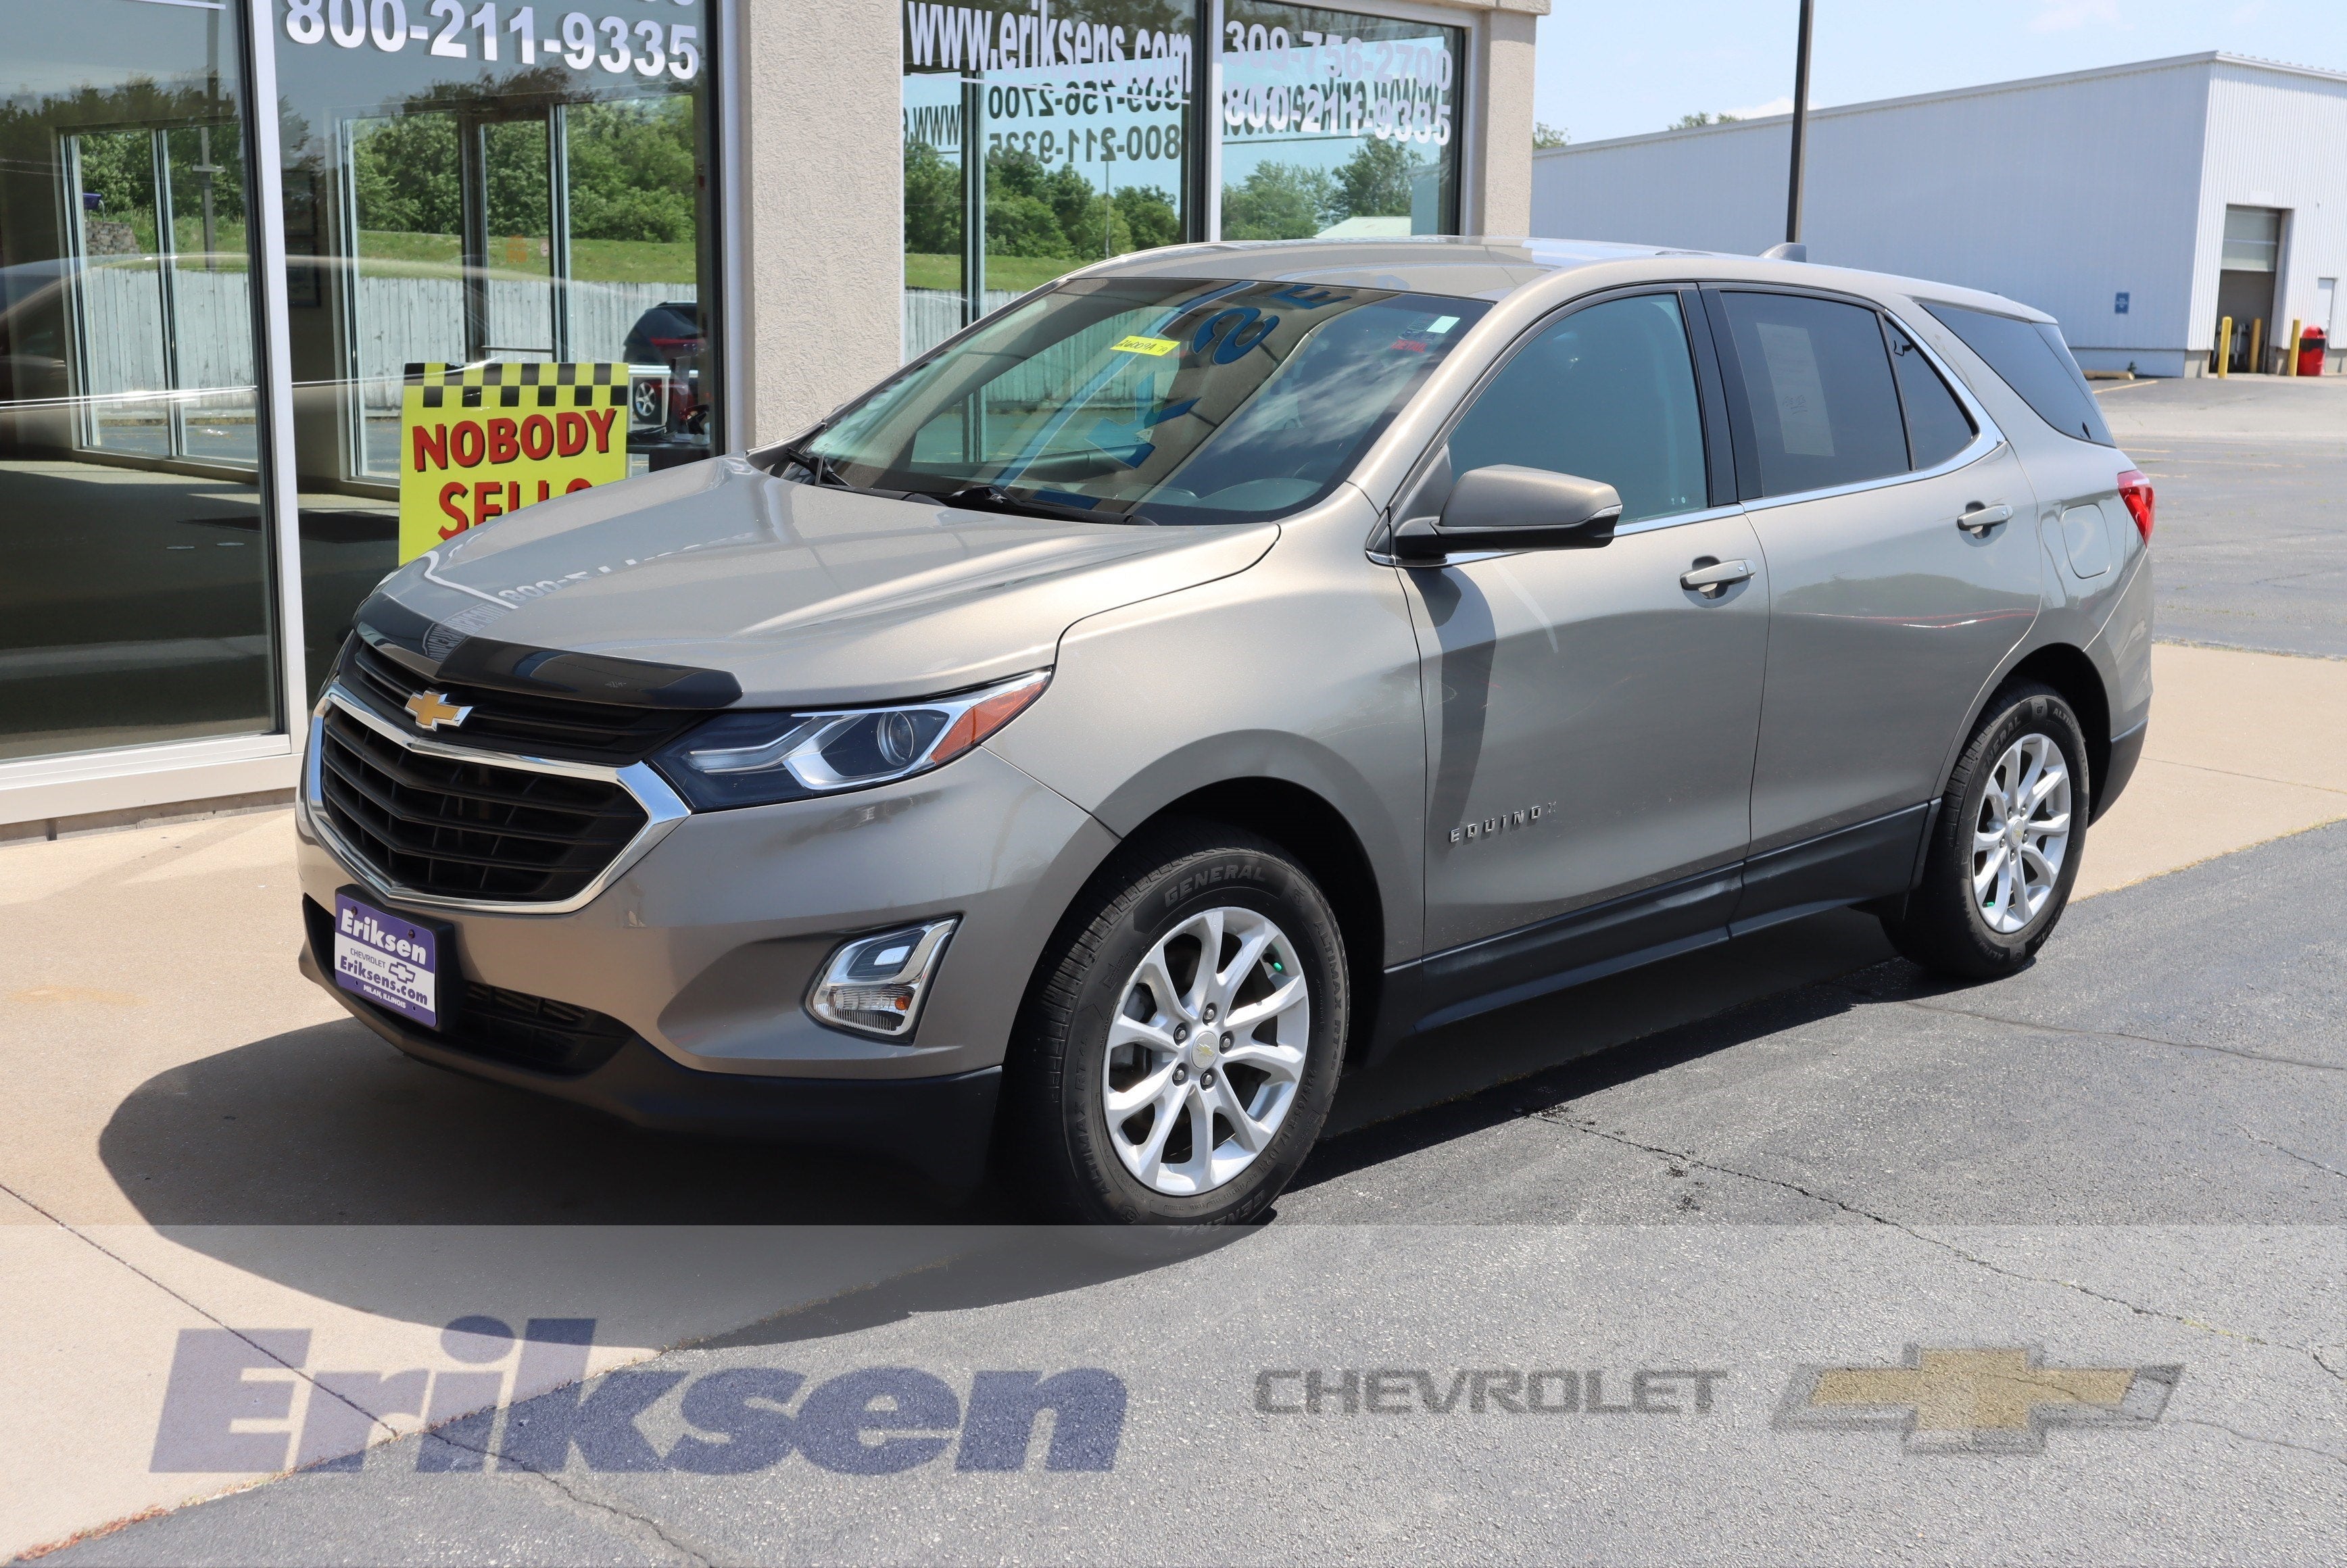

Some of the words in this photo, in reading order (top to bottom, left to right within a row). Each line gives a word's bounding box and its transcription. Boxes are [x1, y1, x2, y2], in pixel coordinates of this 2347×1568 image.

[285, 0, 699, 80] 800-211-9335
[908, 0, 1192, 93] www.eriksens.com
[1226, 20, 1453, 91] 309-756-2700
[1224, 80, 1452, 146] 800-211-9335
[412, 408, 618, 472] NOBODY
[1450, 801, 1557, 843] EQUINOX
[1164, 864, 1266, 908] GENERAL
[340, 908, 427, 965] Eriksen
[350, 948, 387, 969] CHEVROLET
[339, 955, 428, 1006] Eriksens.com
[363, 984, 383, 1000] MILAN,
[383, 993, 406, 1010] ILLINOIS
